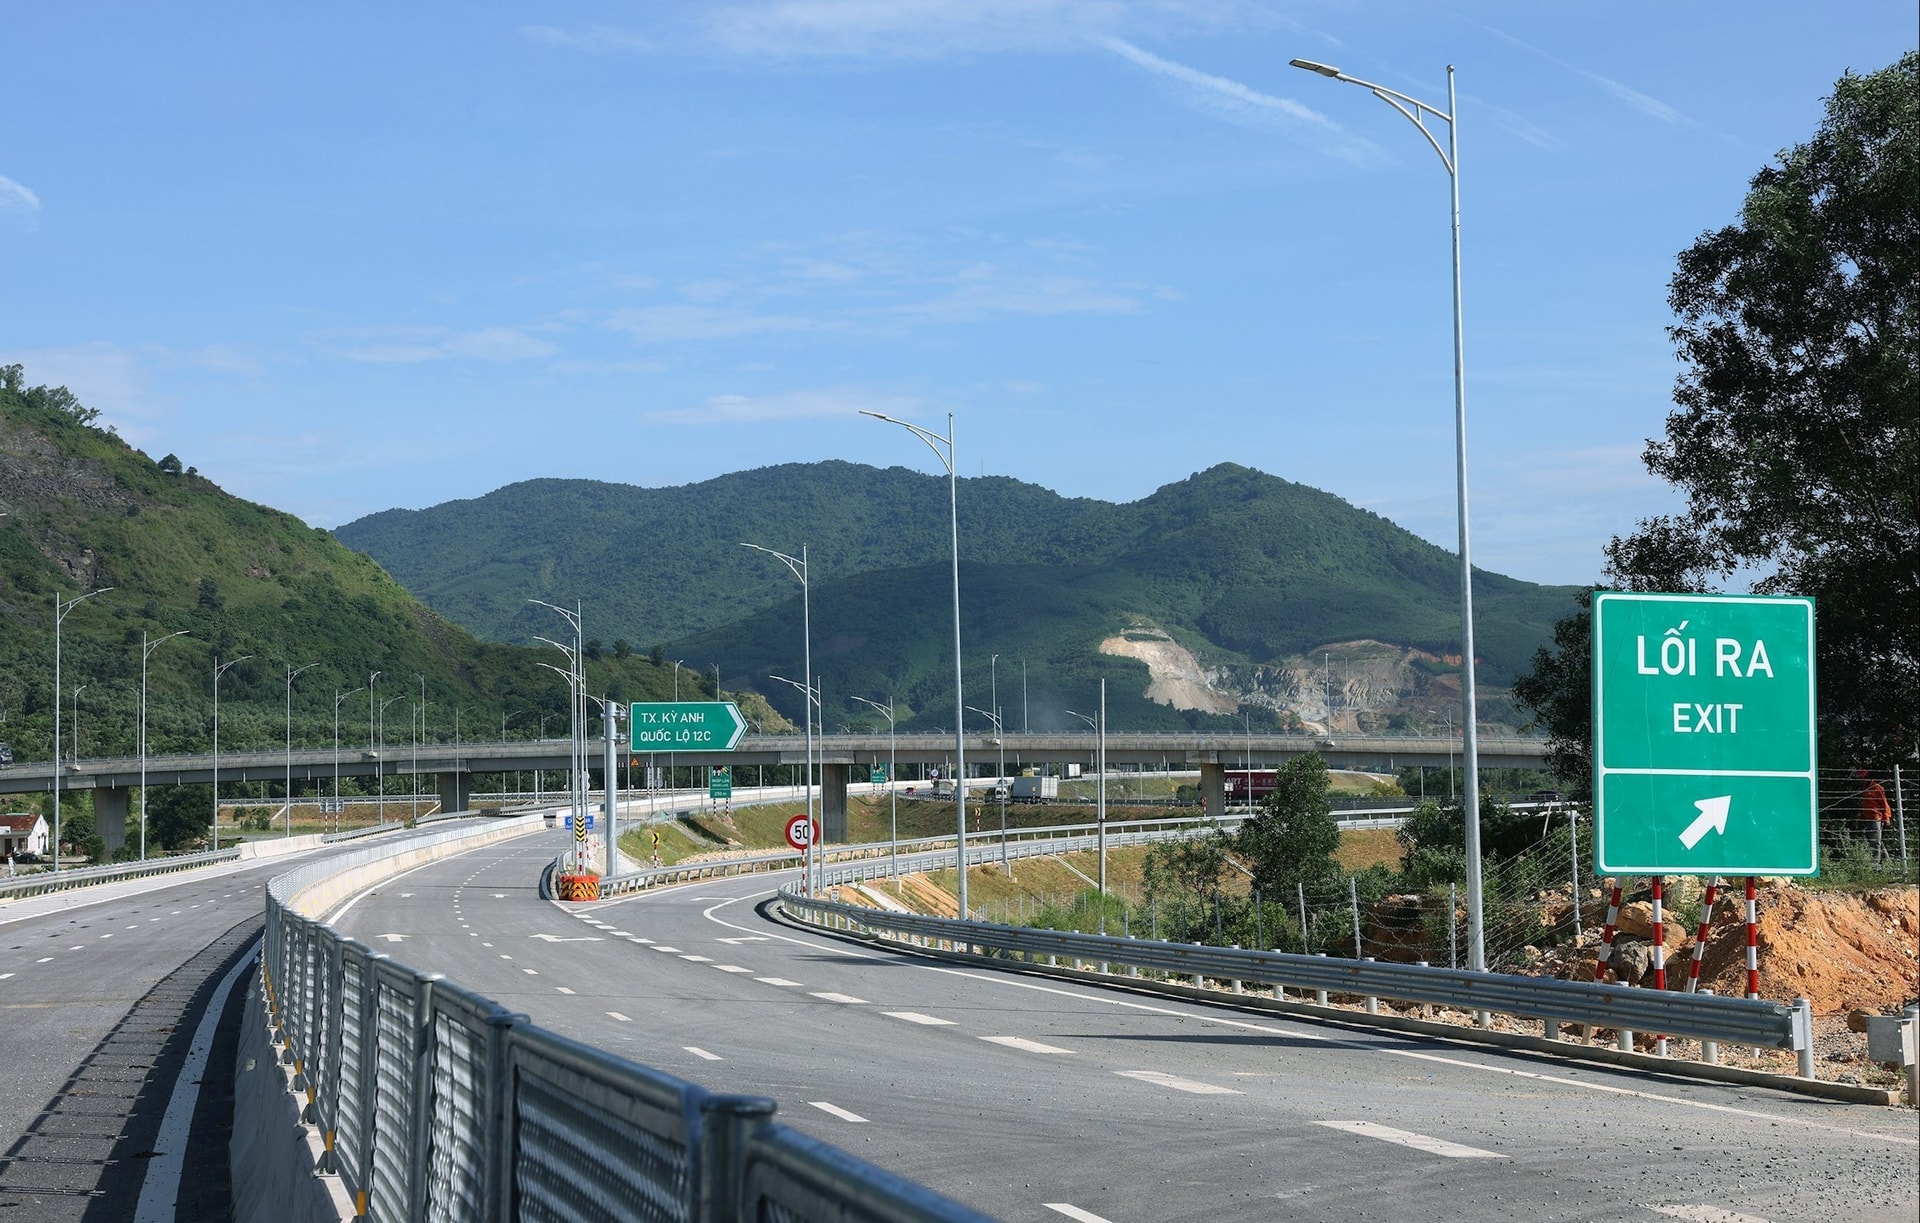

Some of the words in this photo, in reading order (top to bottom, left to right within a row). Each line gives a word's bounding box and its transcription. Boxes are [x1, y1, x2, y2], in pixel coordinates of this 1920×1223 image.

[1637, 620, 1696, 676] LỐI
[1715, 638, 1774, 678] RA
[641, 712, 660, 723] TX.
[662, 709, 678, 723] KỲ
[680, 713, 704, 723] ANH
[1673, 703, 1743, 733] EXIT
[640, 728, 671, 742] QUỐC
[676, 729, 690, 743] LỘ
[693, 731, 711, 741] 12C
